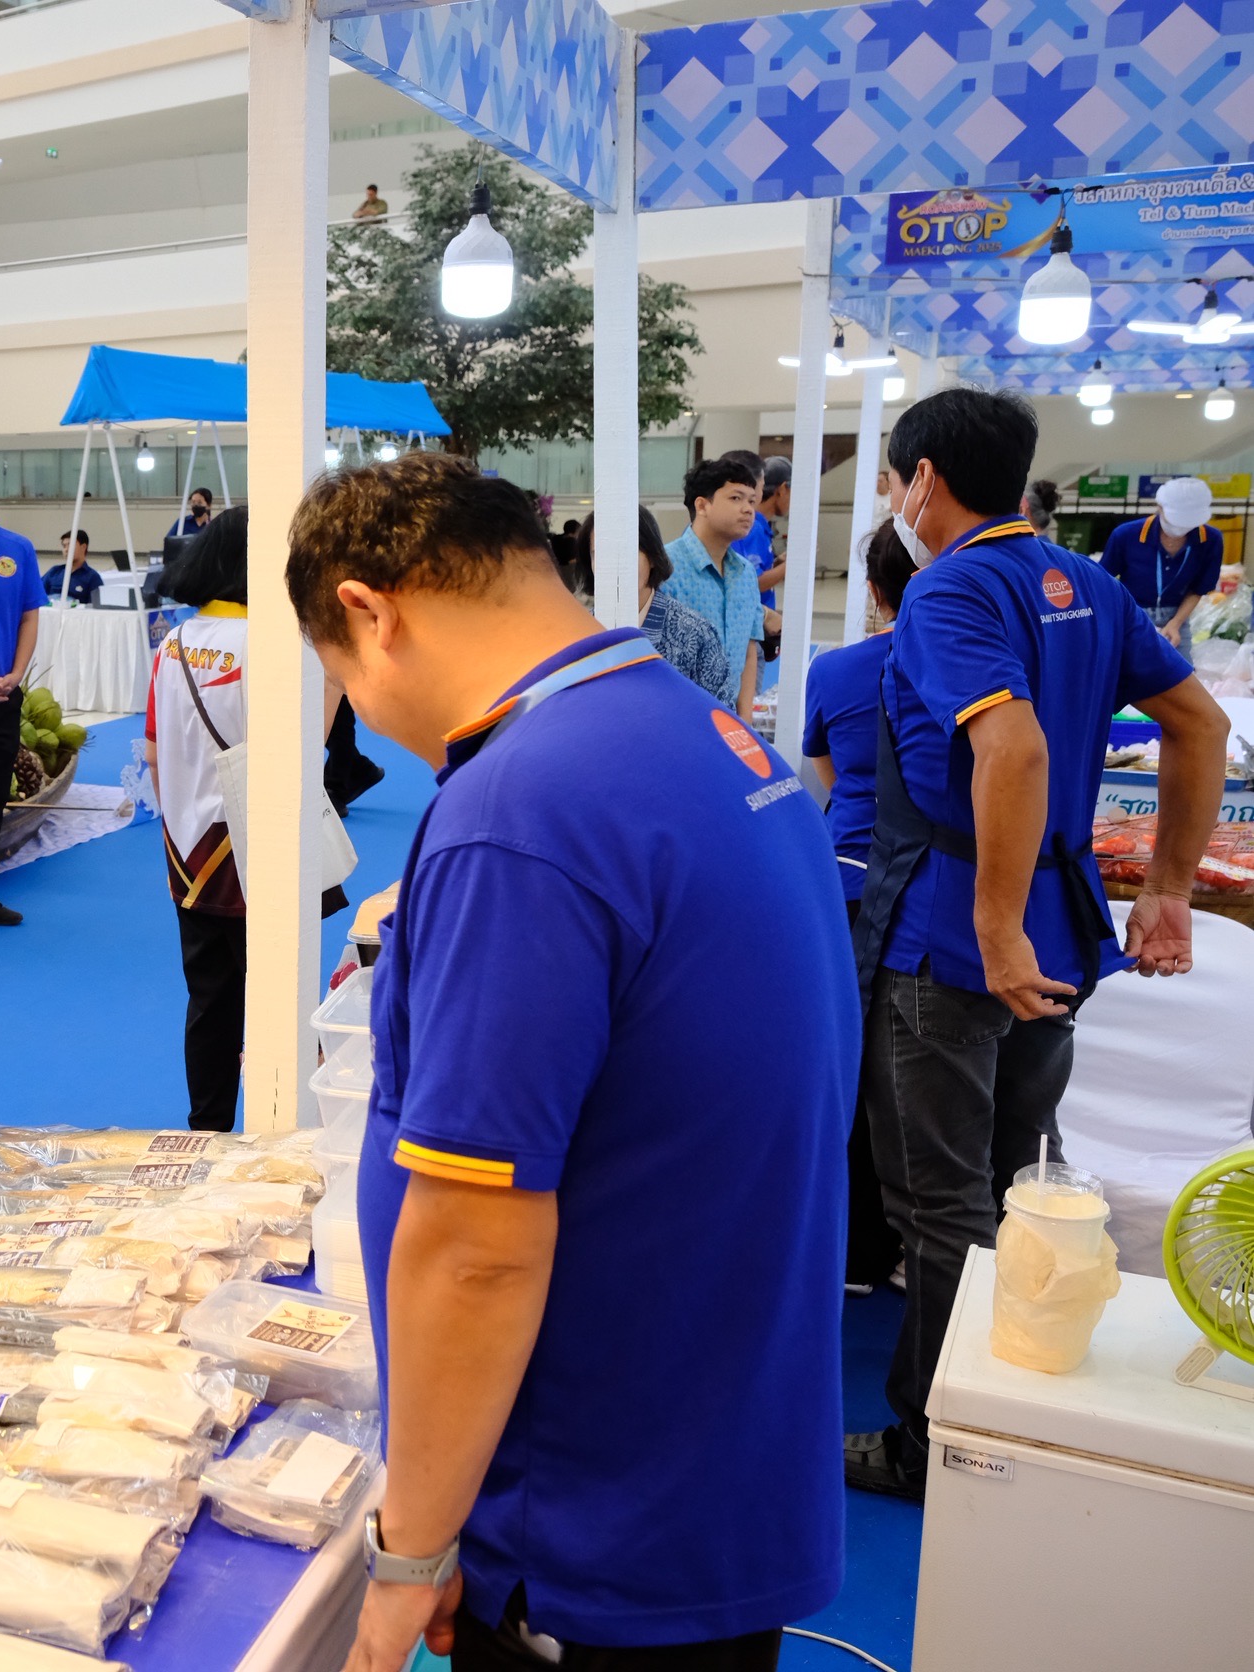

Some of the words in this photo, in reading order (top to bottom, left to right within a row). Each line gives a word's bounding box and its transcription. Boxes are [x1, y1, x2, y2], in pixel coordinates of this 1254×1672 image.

[919, 200, 988, 215] ROADSHOW
[899, 212, 1008, 244] OTOP
[903, 243, 973, 257] MAEKLONG
[1043, 580, 1068, 593] OTOP
[219, 652, 235, 673] 3
[951, 1454, 1005, 1473] SONAR
